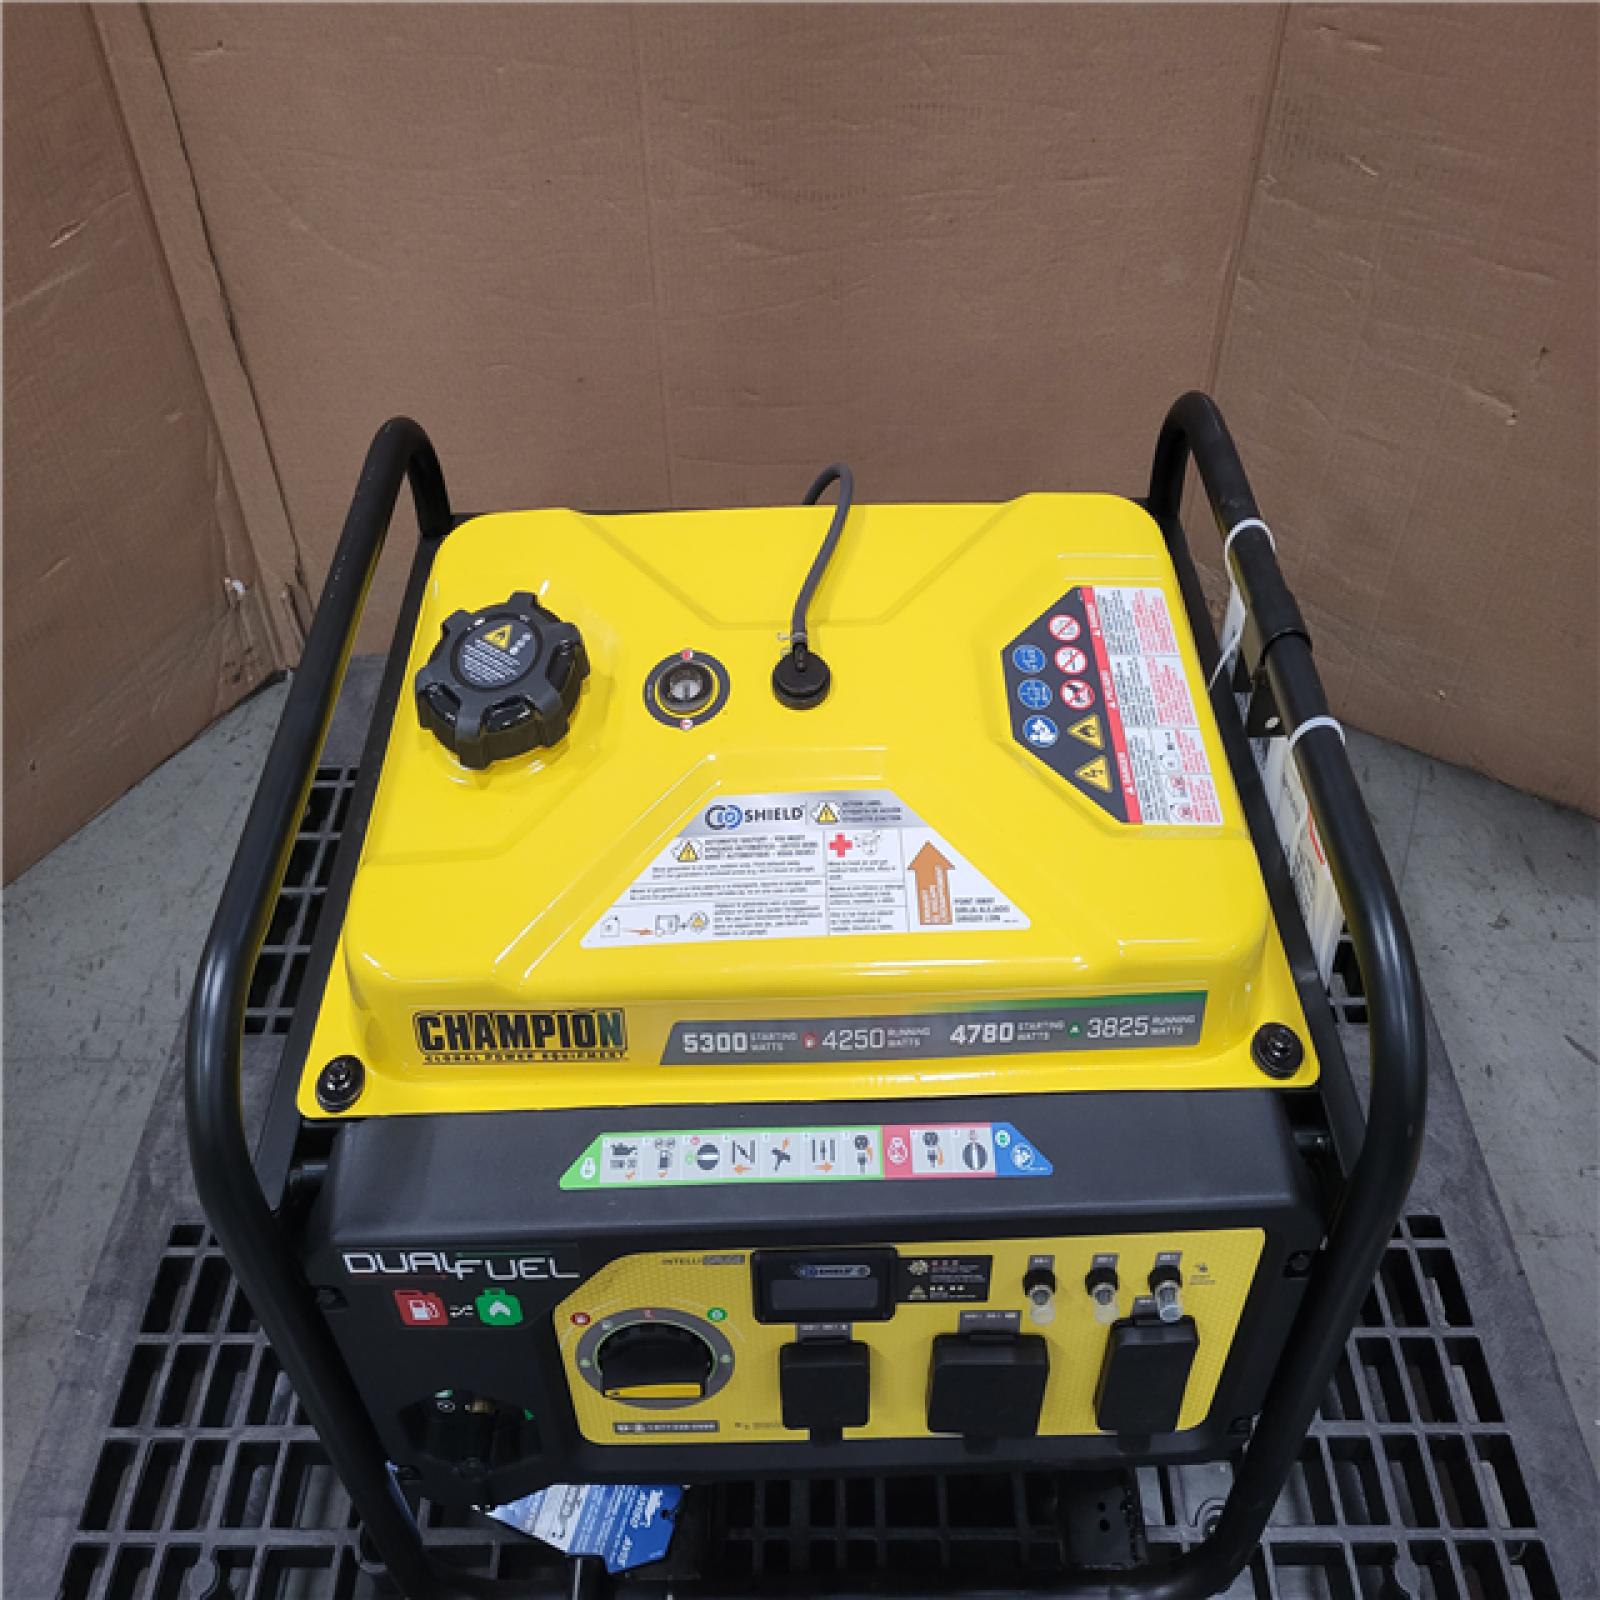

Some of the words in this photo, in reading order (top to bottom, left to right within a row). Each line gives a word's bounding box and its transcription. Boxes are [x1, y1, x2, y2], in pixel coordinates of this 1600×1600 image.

[744, 807, 803, 823] SHIELD
[418, 1013, 623, 1051] CHAMPION
[949, 1022, 1014, 1044] 4780
[1087, 1015, 1149, 1039] 3825
[683, 1032, 748, 1054] 5300
[822, 1028, 886, 1050] 4250
